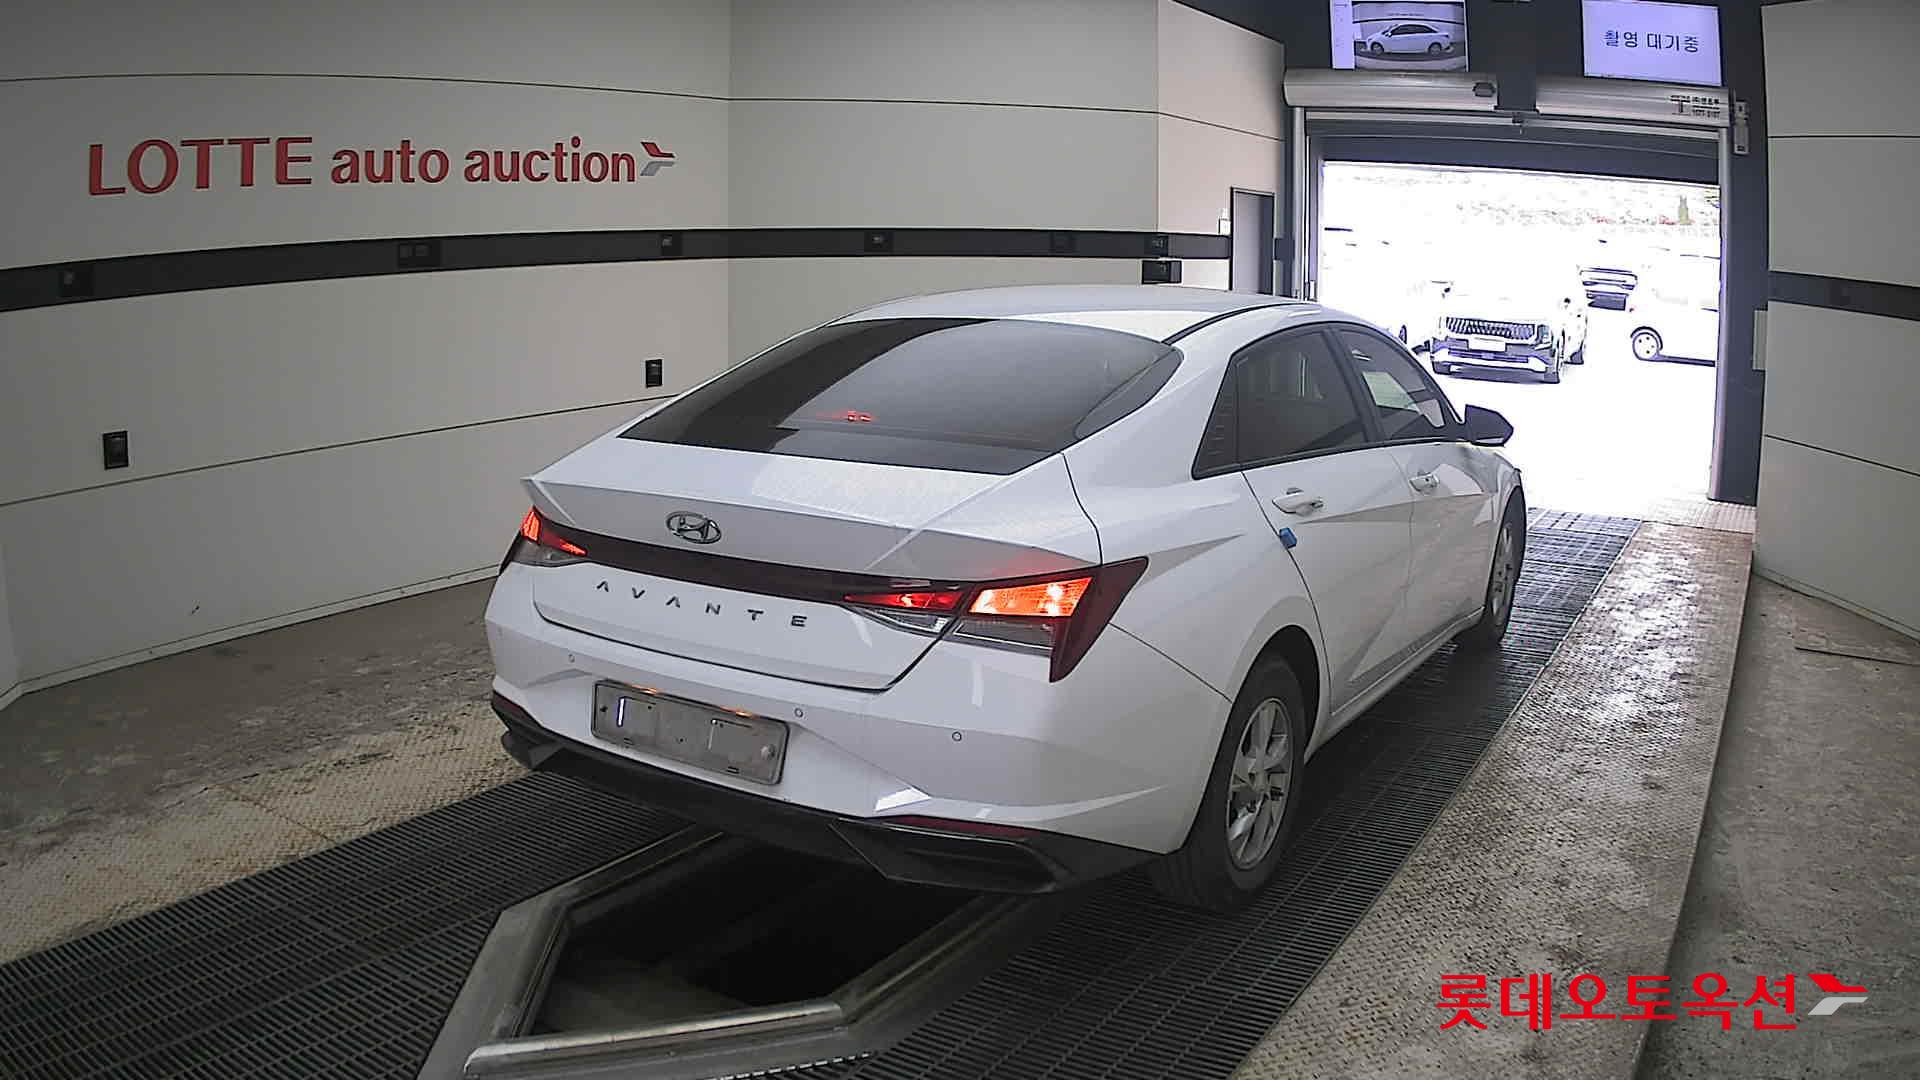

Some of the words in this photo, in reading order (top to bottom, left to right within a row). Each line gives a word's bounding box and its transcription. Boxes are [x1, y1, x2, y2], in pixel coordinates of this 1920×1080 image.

[1603, 30, 1639, 49] 촬영
[1646, 33, 1699, 53] 대기중
[88, 136, 313, 196] LOTTE
[330, 139, 451, 185] auto
[463, 135, 636, 183] auction
[596, 579, 808, 628] AVANTE
